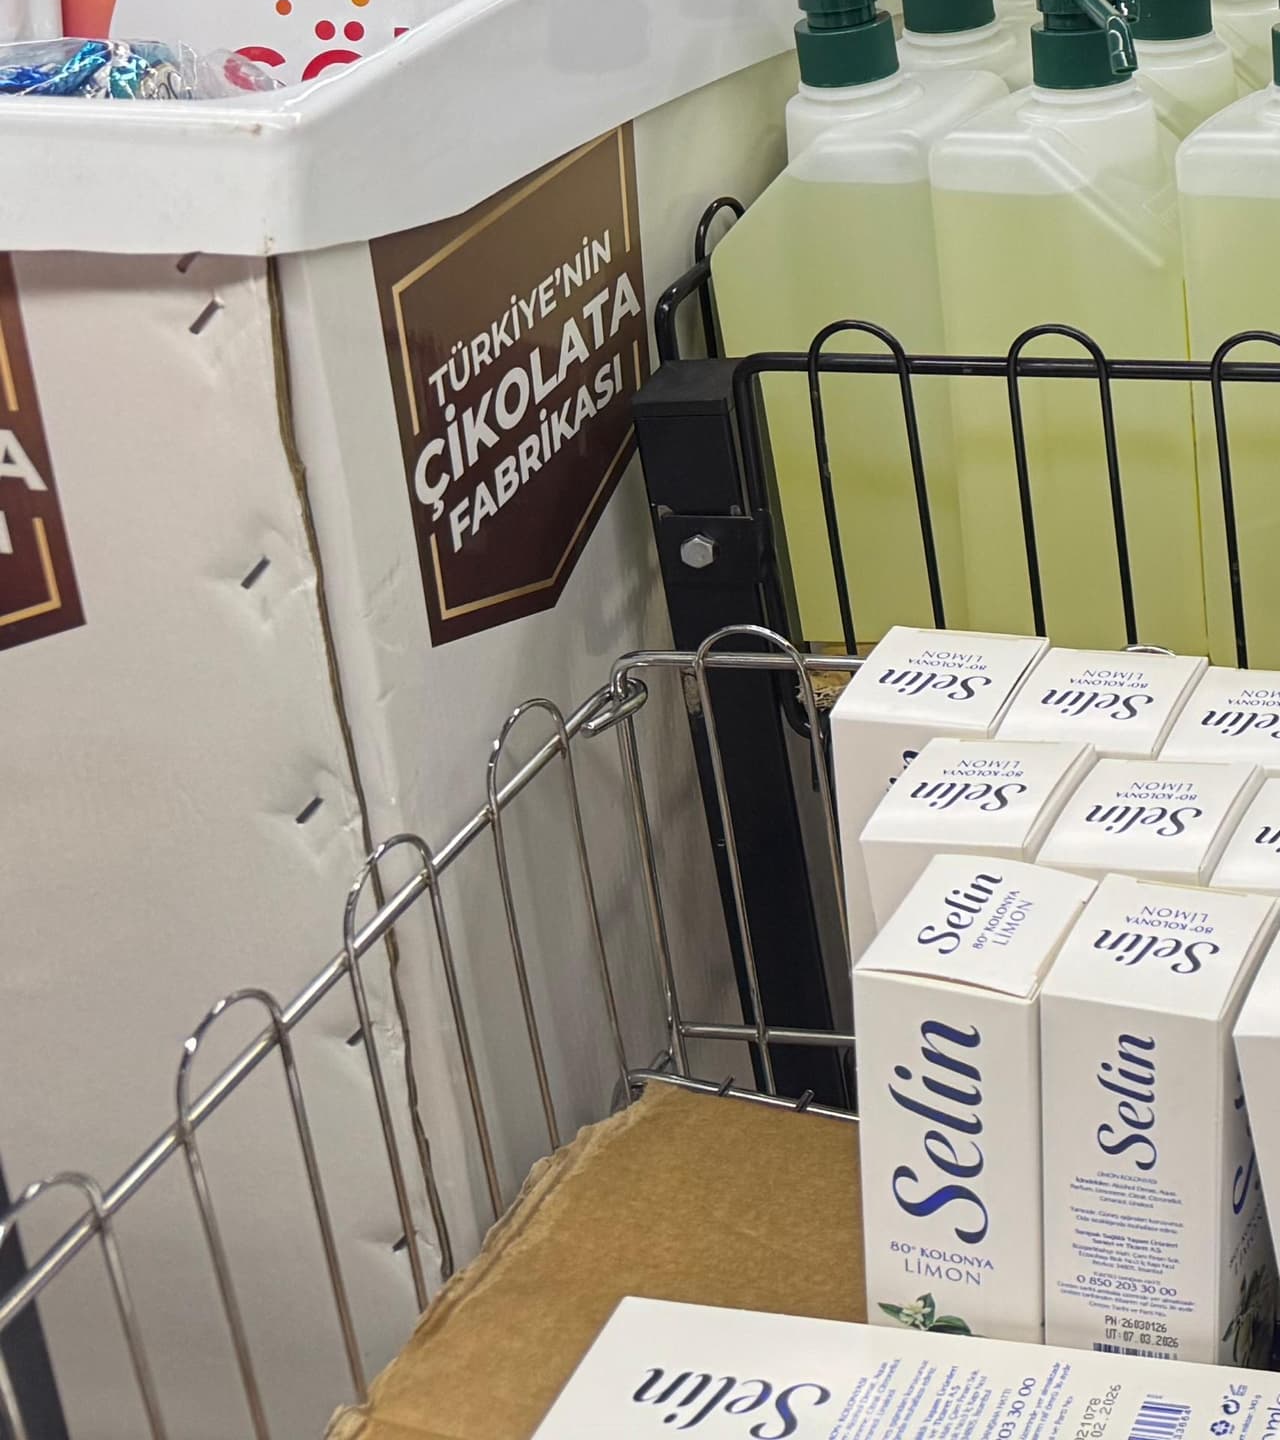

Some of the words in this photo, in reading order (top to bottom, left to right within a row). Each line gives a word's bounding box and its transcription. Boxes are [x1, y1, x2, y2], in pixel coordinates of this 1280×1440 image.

[428, 230, 612, 407] TÜRKİYE'NİN
[414, 271, 641, 522] ÇİKOLATA
[449, 353, 623, 553] FABRİKASI
[920, 649, 984, 665] LİMON
[879, 664, 991, 700] Selin
[1041, 684, 1153, 719] Selin
[911, 782, 1027, 810] Selin
[1086, 805, 1202, 836] Selin
[918, 874, 1009, 954] Selin
[1141, 904, 1209, 924] LİMON
[1094, 925, 1219, 973] Selin
[1097, 1034, 1157, 1176] Selin
[889, 1021, 988, 1250] Selin
[903, 1259, 984, 1287] LİMON
[1089, 1276, 1112, 1288] 850
[1115, 1279, 1138, 1292] 203
[1140, 1284, 1156, 1294] 30
[1159, 1287, 1177, 1297] 00
[633, 1368, 835, 1440] Selin
